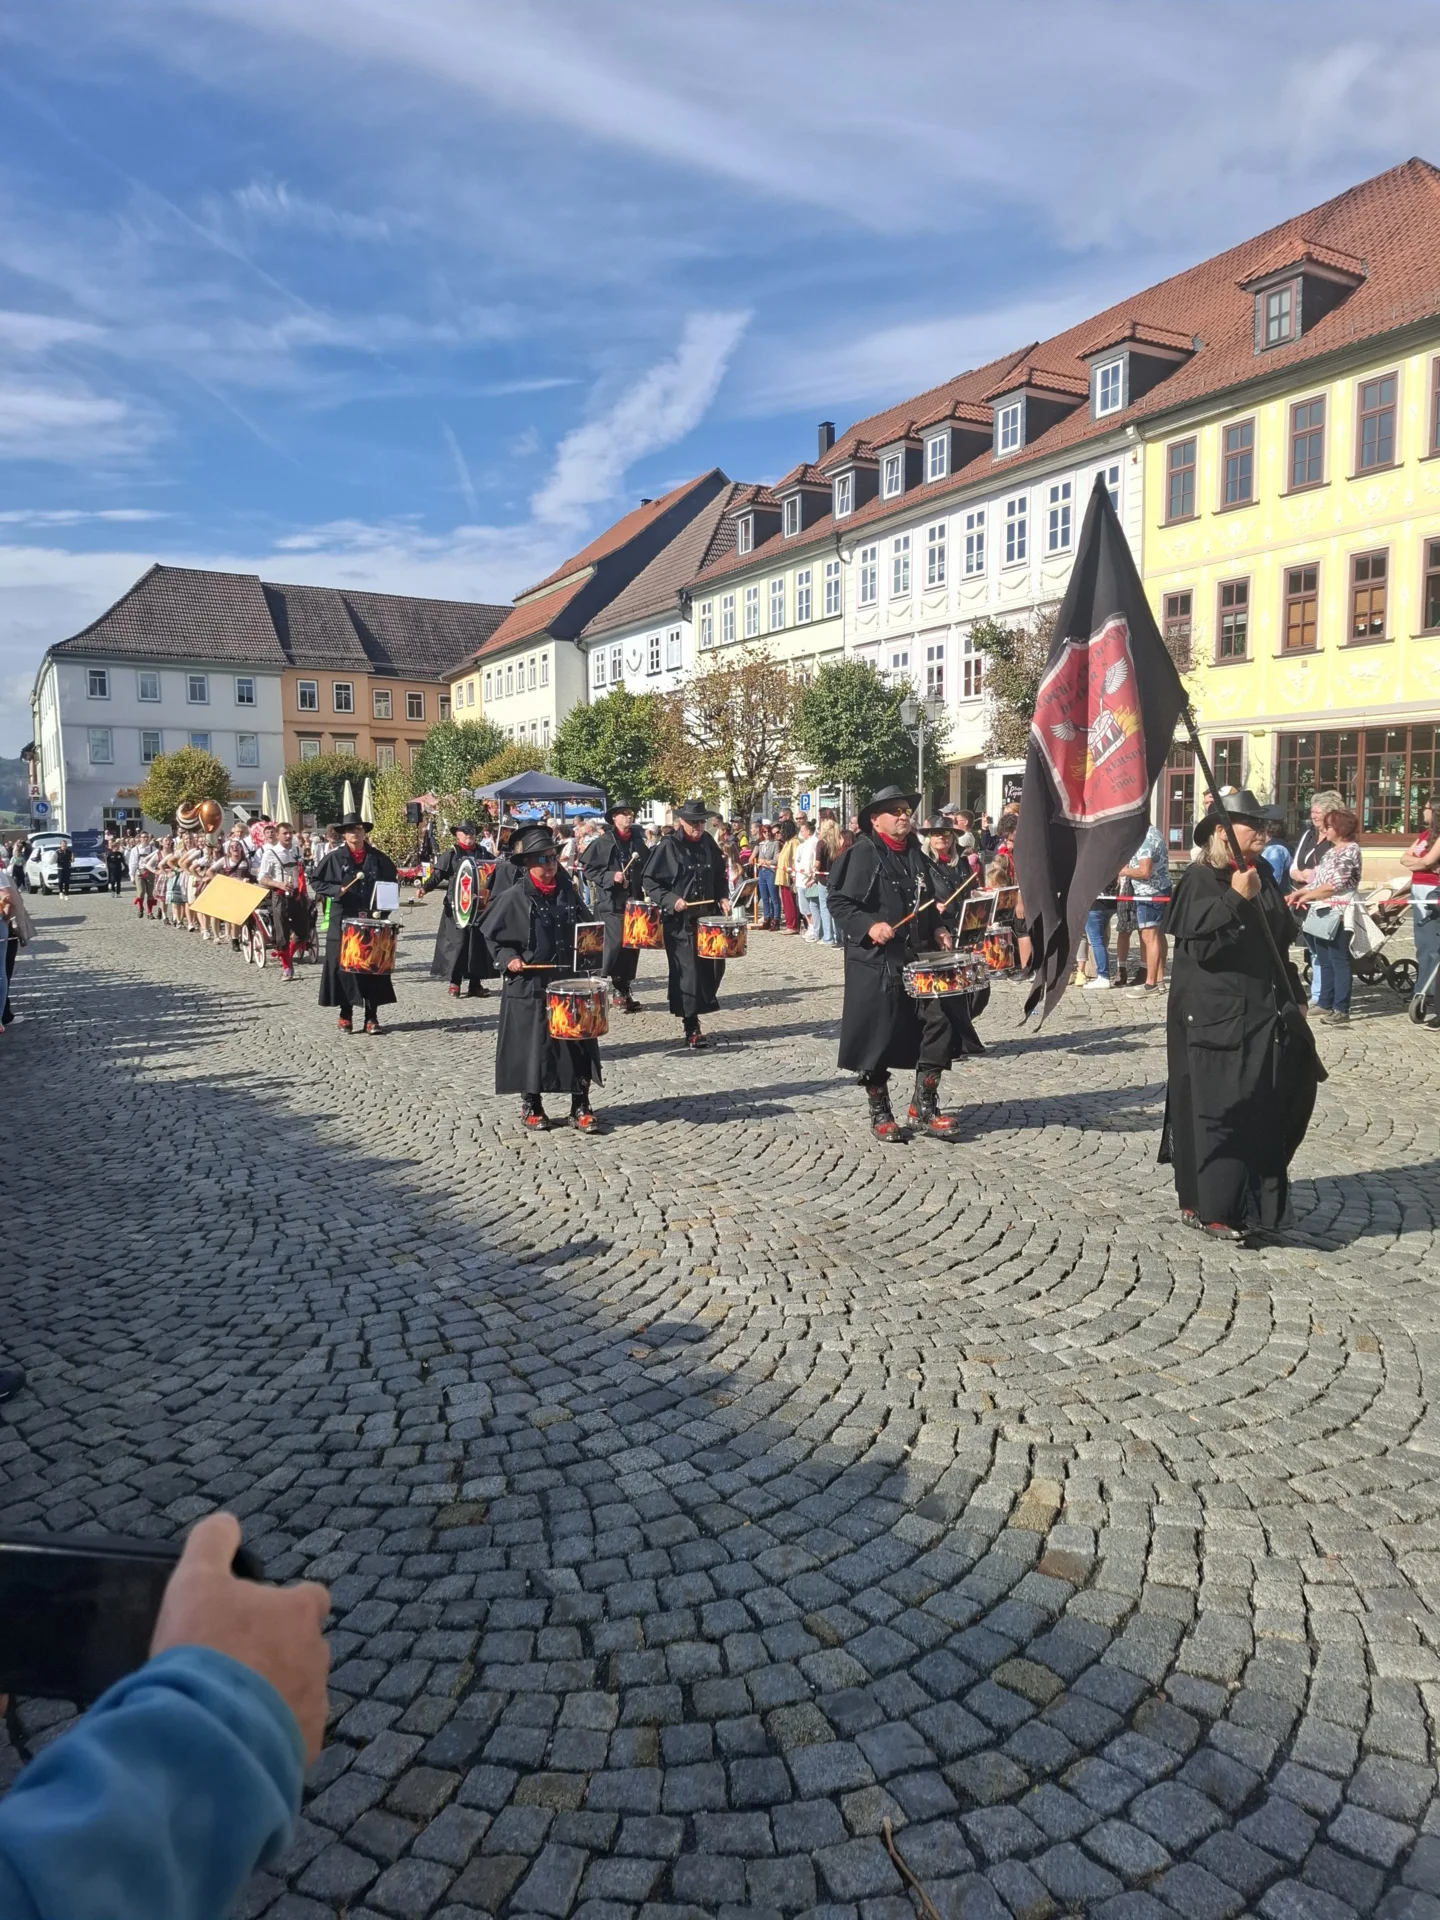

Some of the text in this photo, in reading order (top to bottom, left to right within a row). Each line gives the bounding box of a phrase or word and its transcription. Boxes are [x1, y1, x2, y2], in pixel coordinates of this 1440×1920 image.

[1111, 775, 1136, 794] 2006
[803, 796, 808, 809] P
[118, 811, 125, 819] P
